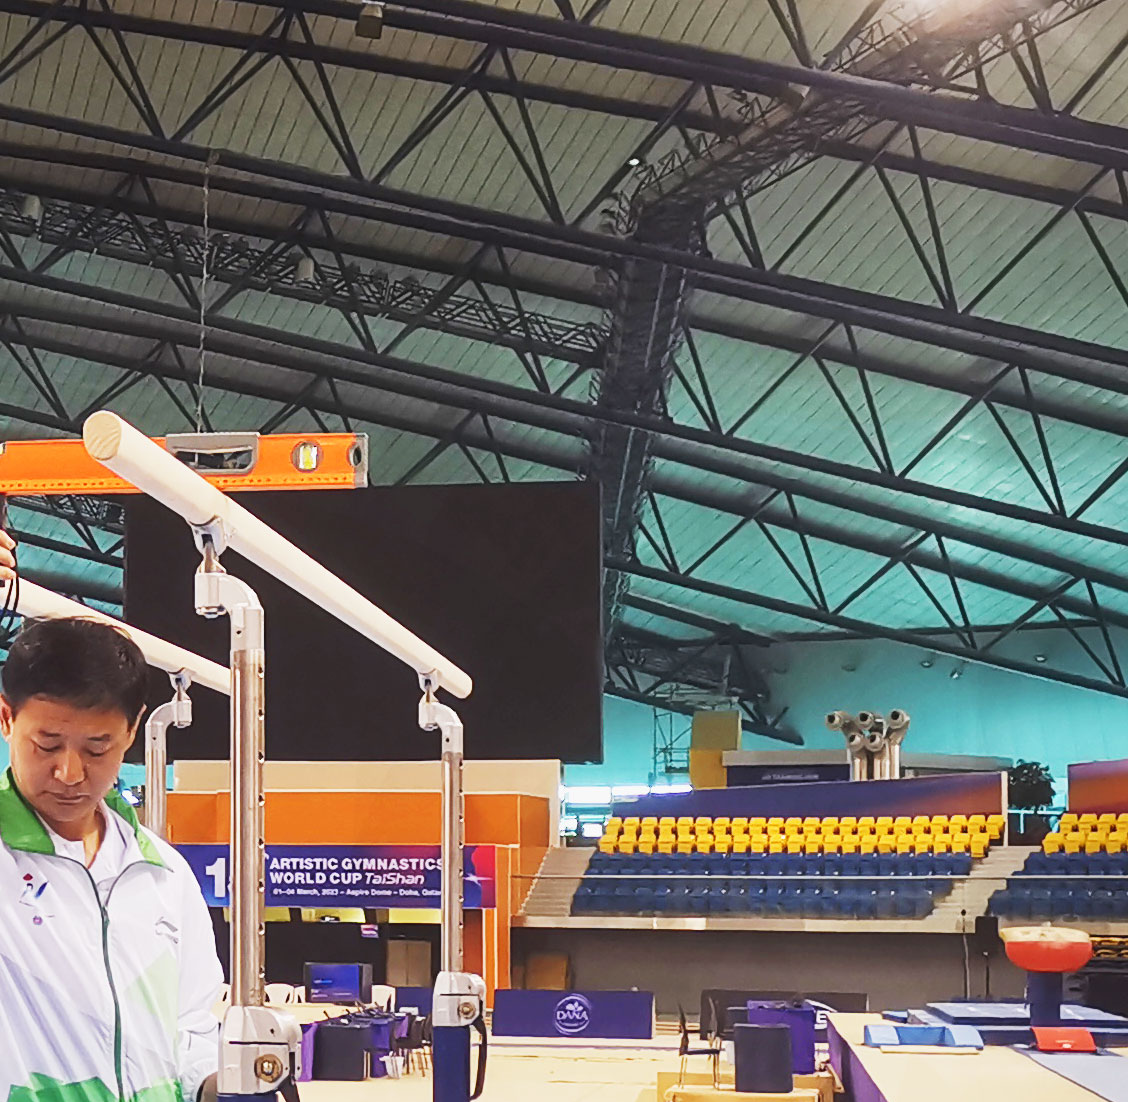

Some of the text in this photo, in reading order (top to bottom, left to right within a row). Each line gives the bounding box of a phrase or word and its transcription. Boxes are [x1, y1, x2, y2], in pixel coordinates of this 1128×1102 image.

[269, 857, 339, 870] ARTISTIC
[269, 871, 425, 885] WORLD CUP TaiShan
[421, 888, 442, 896] Qata
